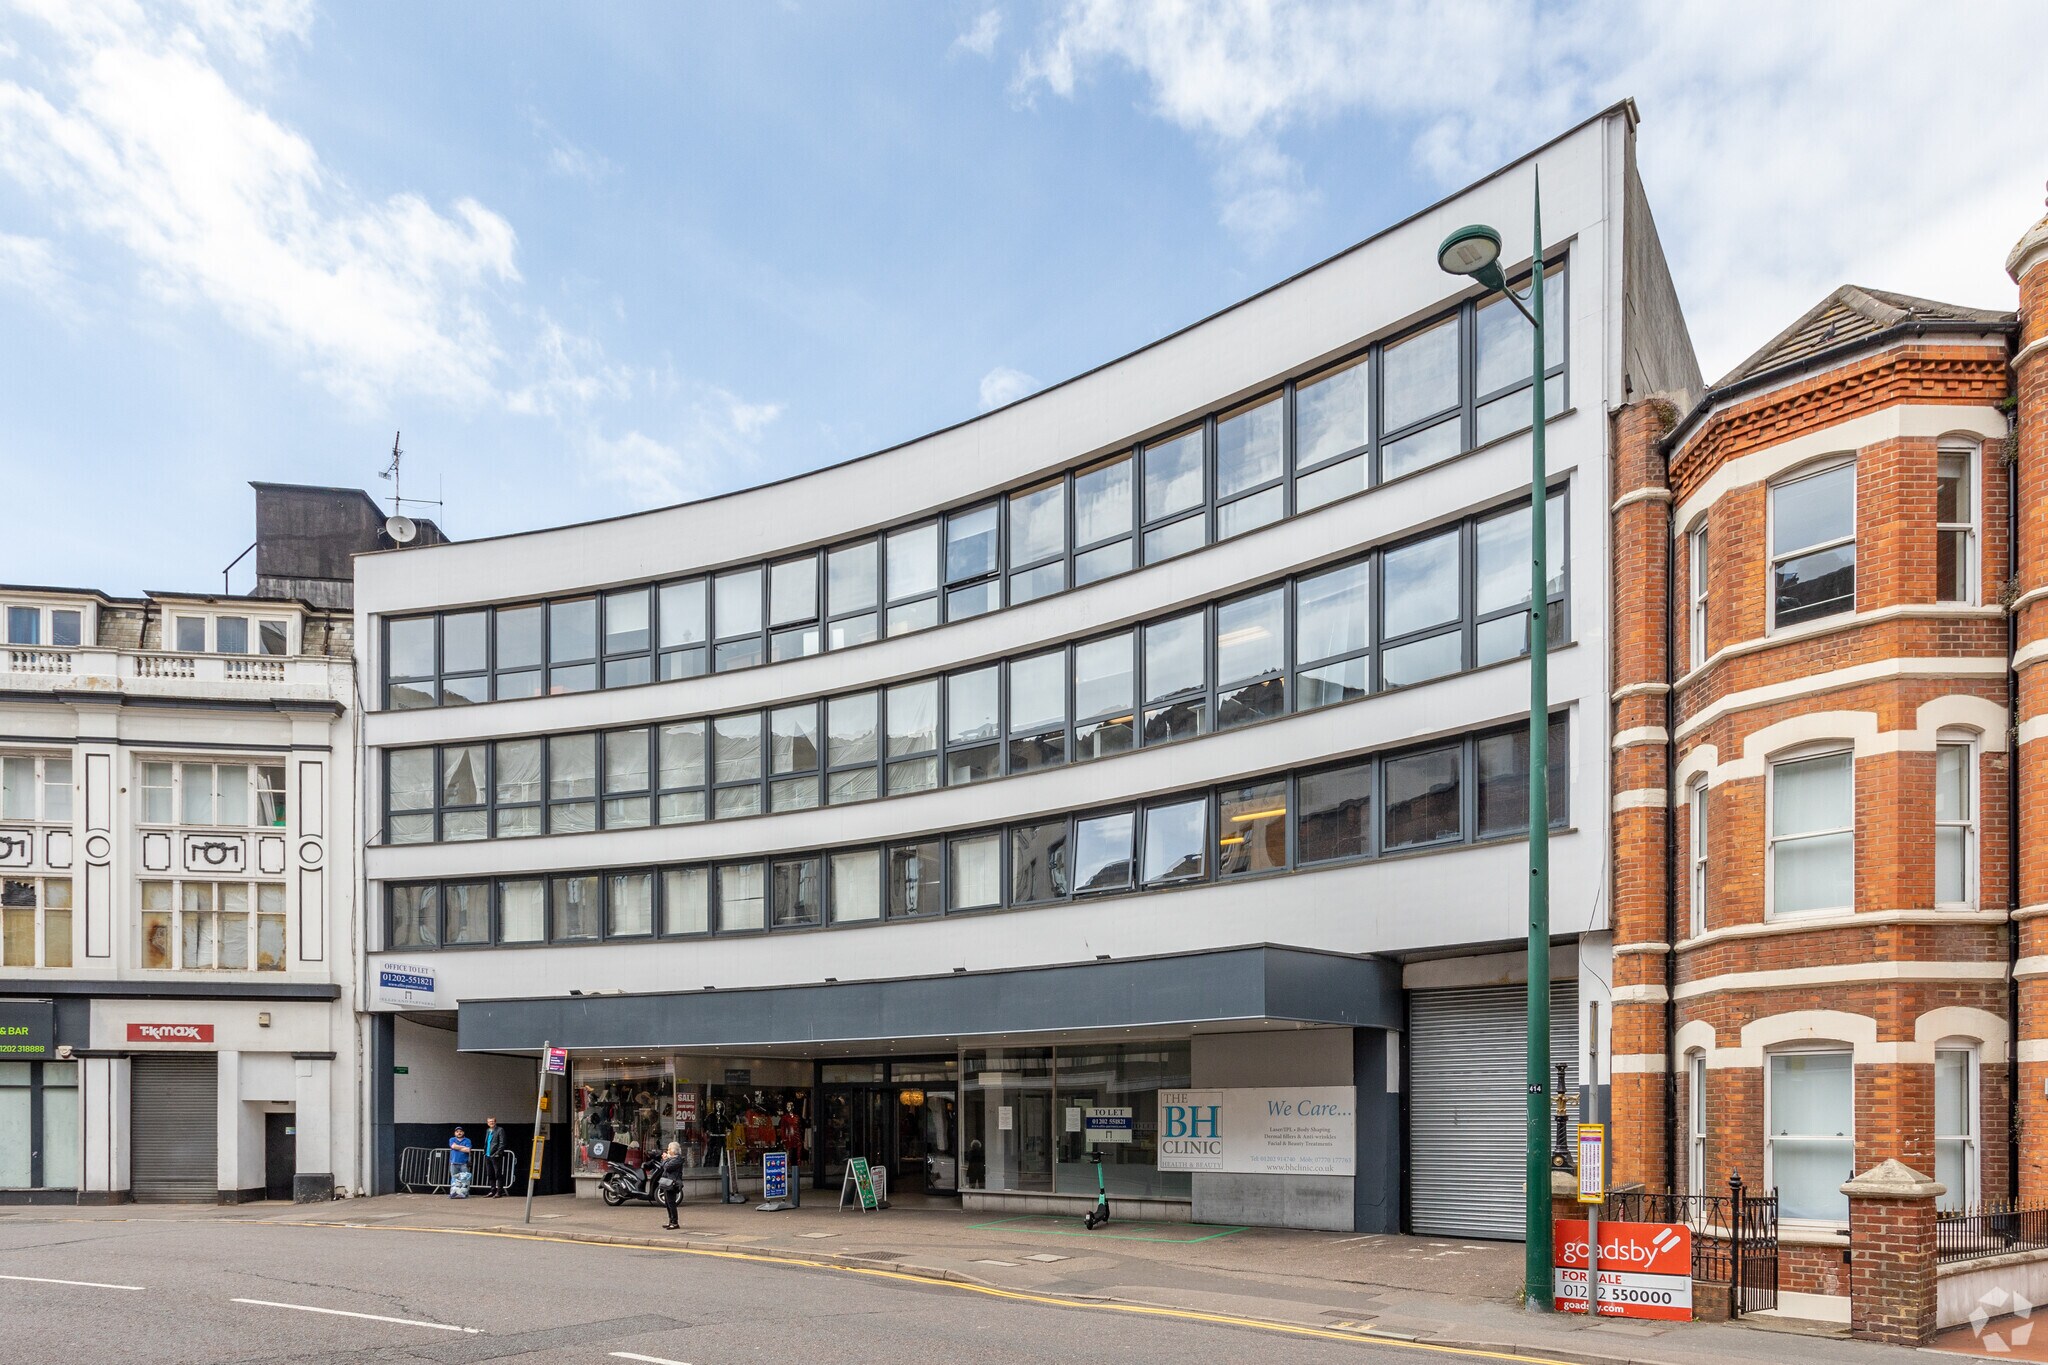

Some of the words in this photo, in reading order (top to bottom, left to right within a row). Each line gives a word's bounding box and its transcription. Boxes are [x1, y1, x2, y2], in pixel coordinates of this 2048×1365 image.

[384, 963, 408, 972] OFFICE
[382, 973, 432, 986] 01202-551821
[8, 1026, 28, 1035] BAR
[1164, 1094, 1188, 1103] THE
[1268, 1100, 1292, 1116] We
[1297, 1100, 1352, 1116] Care...
[676, 1110, 696, 1120] 20%
[1162, 1106, 1221, 1137] BH
[1163, 1140, 1221, 1154] CLINIC
[1266, 1164, 1334, 1172] www.bhclinic.co.uk
[1562, 1270, 1588, 1281] FOR
[1564, 1284, 1606, 1300] 0122
[1612, 1288, 1672, 1304] 550000
[1563, 1300, 1624, 1313] goadsy.com
